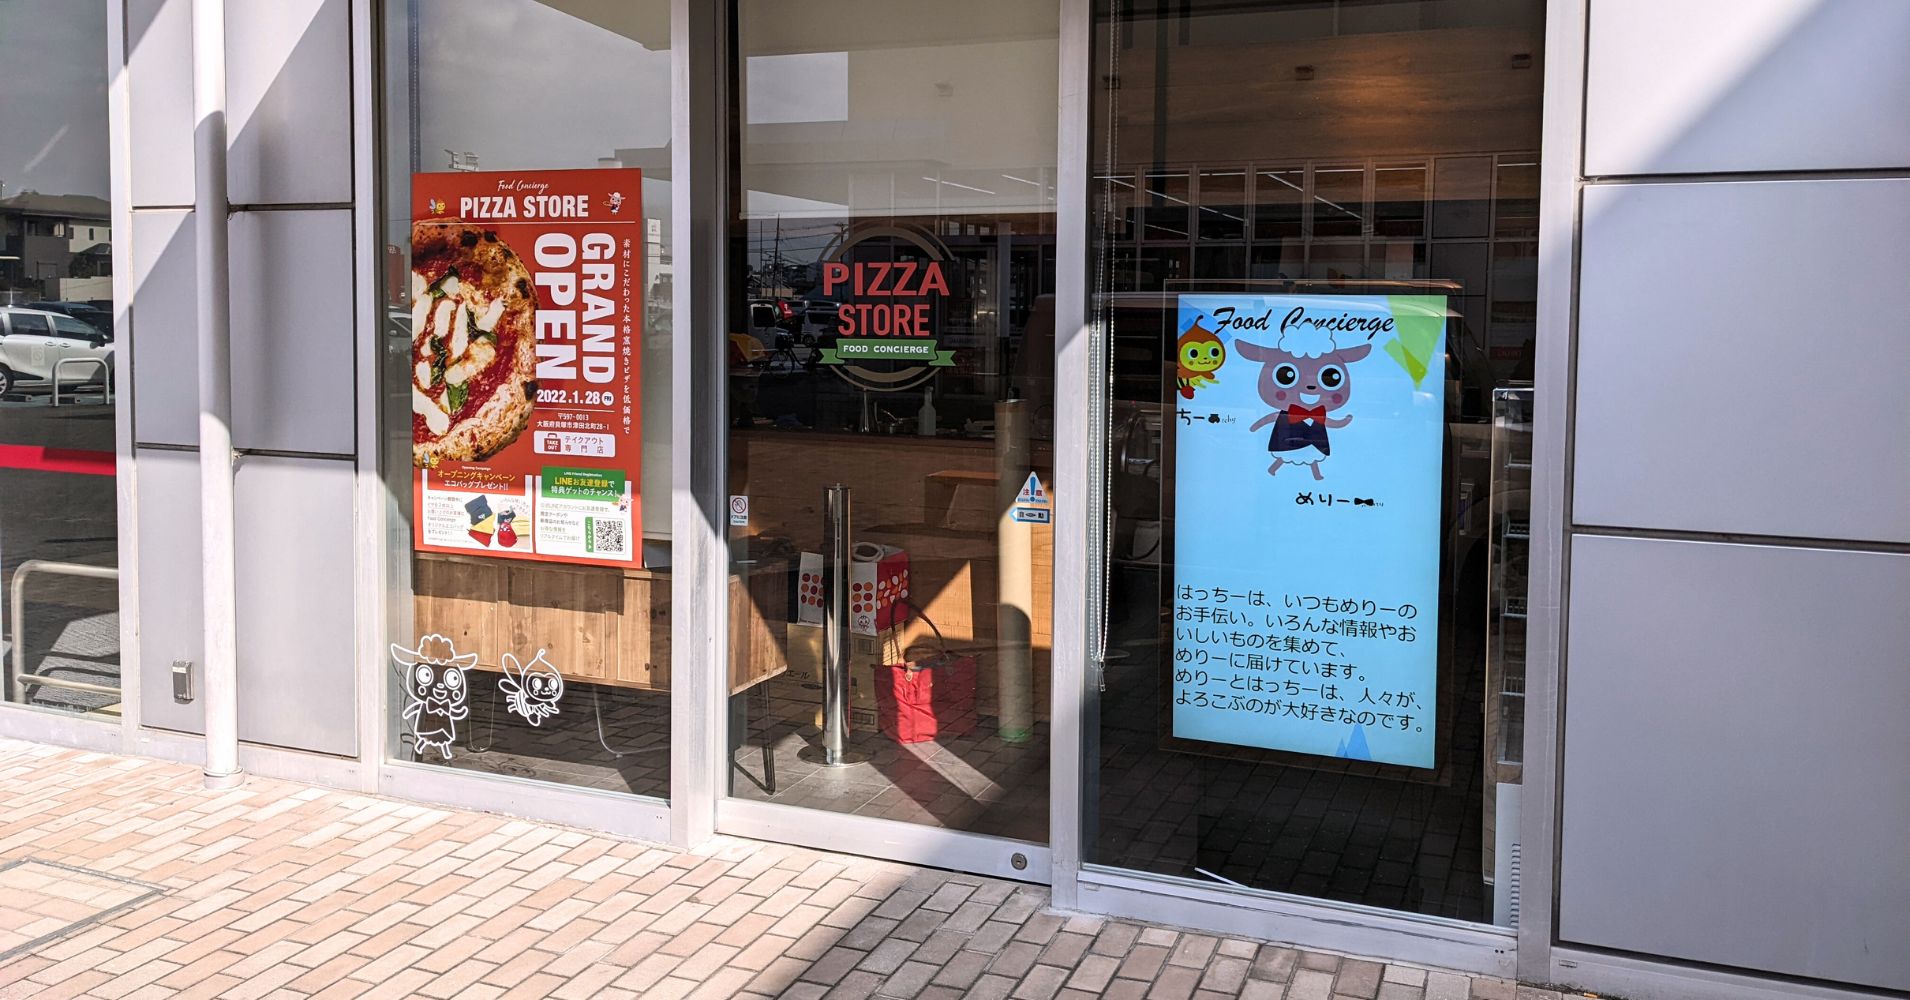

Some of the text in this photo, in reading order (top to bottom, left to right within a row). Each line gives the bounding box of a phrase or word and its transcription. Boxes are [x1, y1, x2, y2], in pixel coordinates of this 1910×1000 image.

[498, 180, 549, 194] Food Concierge
[460, 195, 588, 218] PIZZA STORE
[823, 262, 950, 296] PIZZA
[534, 233, 577, 380] OPEN
[582, 233, 616, 383] GRAND
[838, 304, 930, 336] STORE
[1213, 306, 1272, 334] Food
[843, 345, 929, 354] FOOD CONCIERGE
[536, 389, 600, 404] 2022.1.28
[565, 435, 604, 445] テイクアウト
[438, 470, 516, 482] オープニングキャンペーン
[554, 476, 615, 488] LINEお友達登録で
[1295, 491, 1350, 507] めりー
[1176, 584, 1418, 619] はっちーは、いつもめりーの
[1176, 605, 1416, 642] お手伝い。いろんな情報やお
[1176, 628, 1346, 658] いしいものを集めて、
[1175, 648, 1366, 682] めりーに届けています。
[1175, 669, 1422, 710] めりーとはっちーは、人々が、
[1175, 690, 1422, 733] よろこぶのが大好きなのです。
